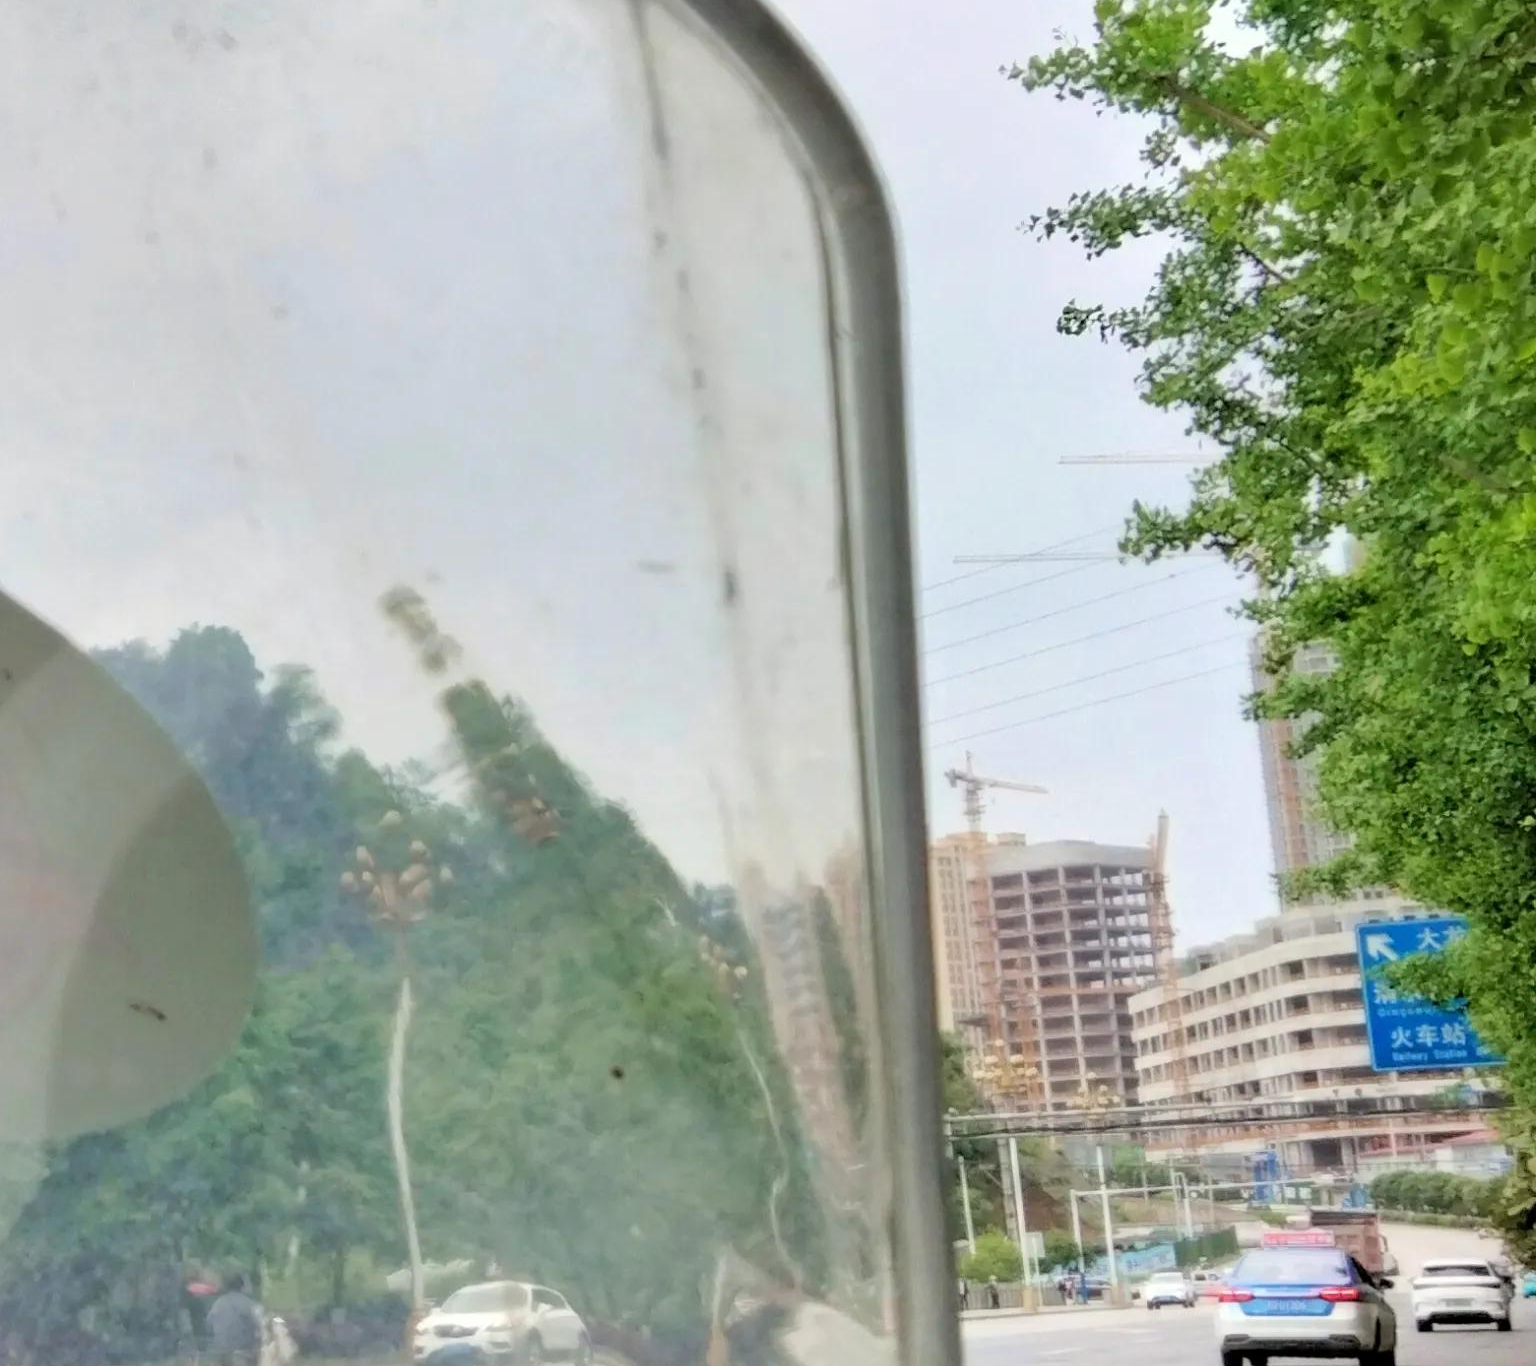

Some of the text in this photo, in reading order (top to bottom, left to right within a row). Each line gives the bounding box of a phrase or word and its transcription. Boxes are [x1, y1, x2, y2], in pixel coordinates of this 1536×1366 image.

[1391, 1022, 1467, 1049] 火车站
[1392, 1050, 1428, 1062] Railway
[1433, 1048, 1468, 1061] Station
